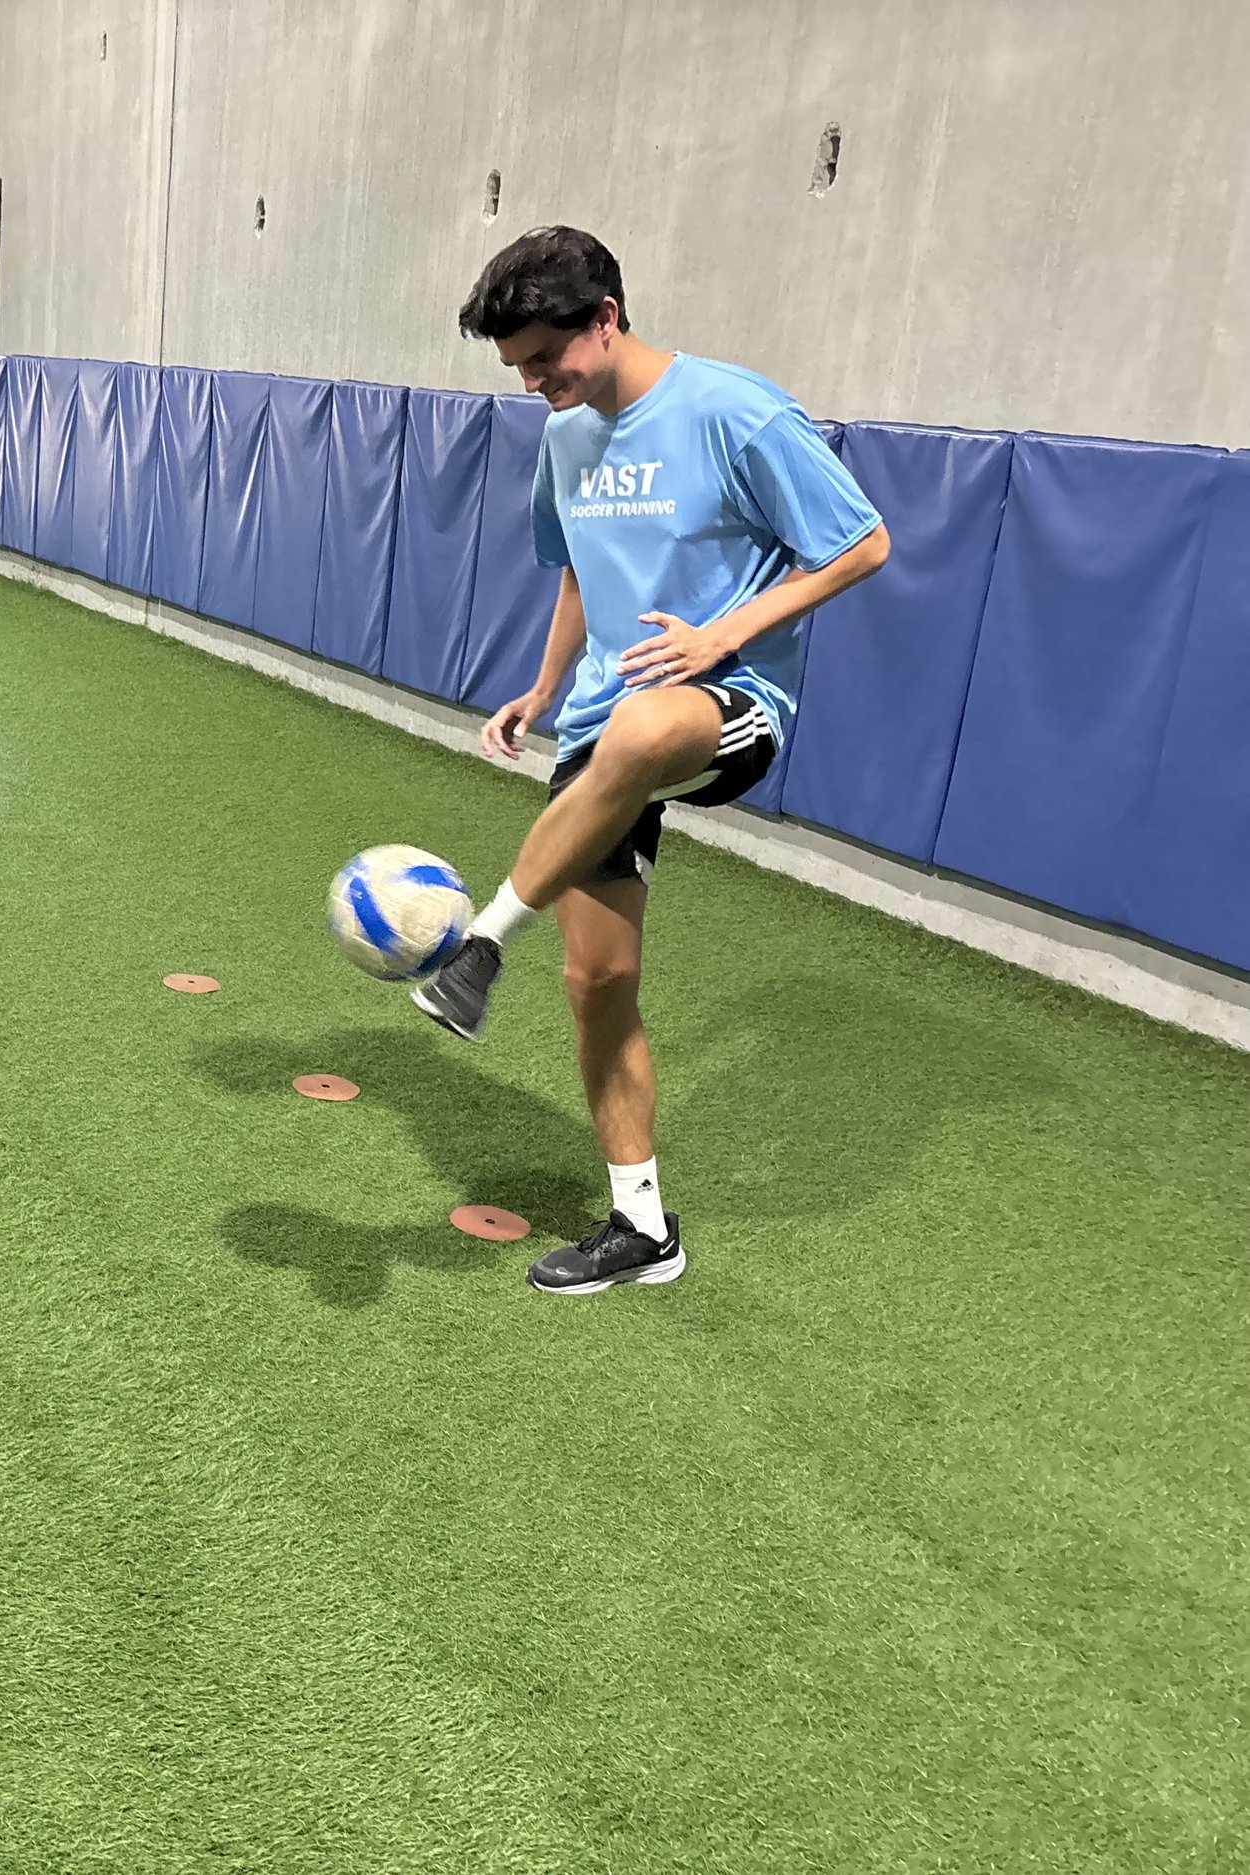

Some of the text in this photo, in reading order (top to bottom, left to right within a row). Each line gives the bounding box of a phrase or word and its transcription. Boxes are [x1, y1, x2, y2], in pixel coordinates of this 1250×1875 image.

[580, 461, 664, 498] VAST
[570, 500, 677, 518] SOCCER TRAINING
